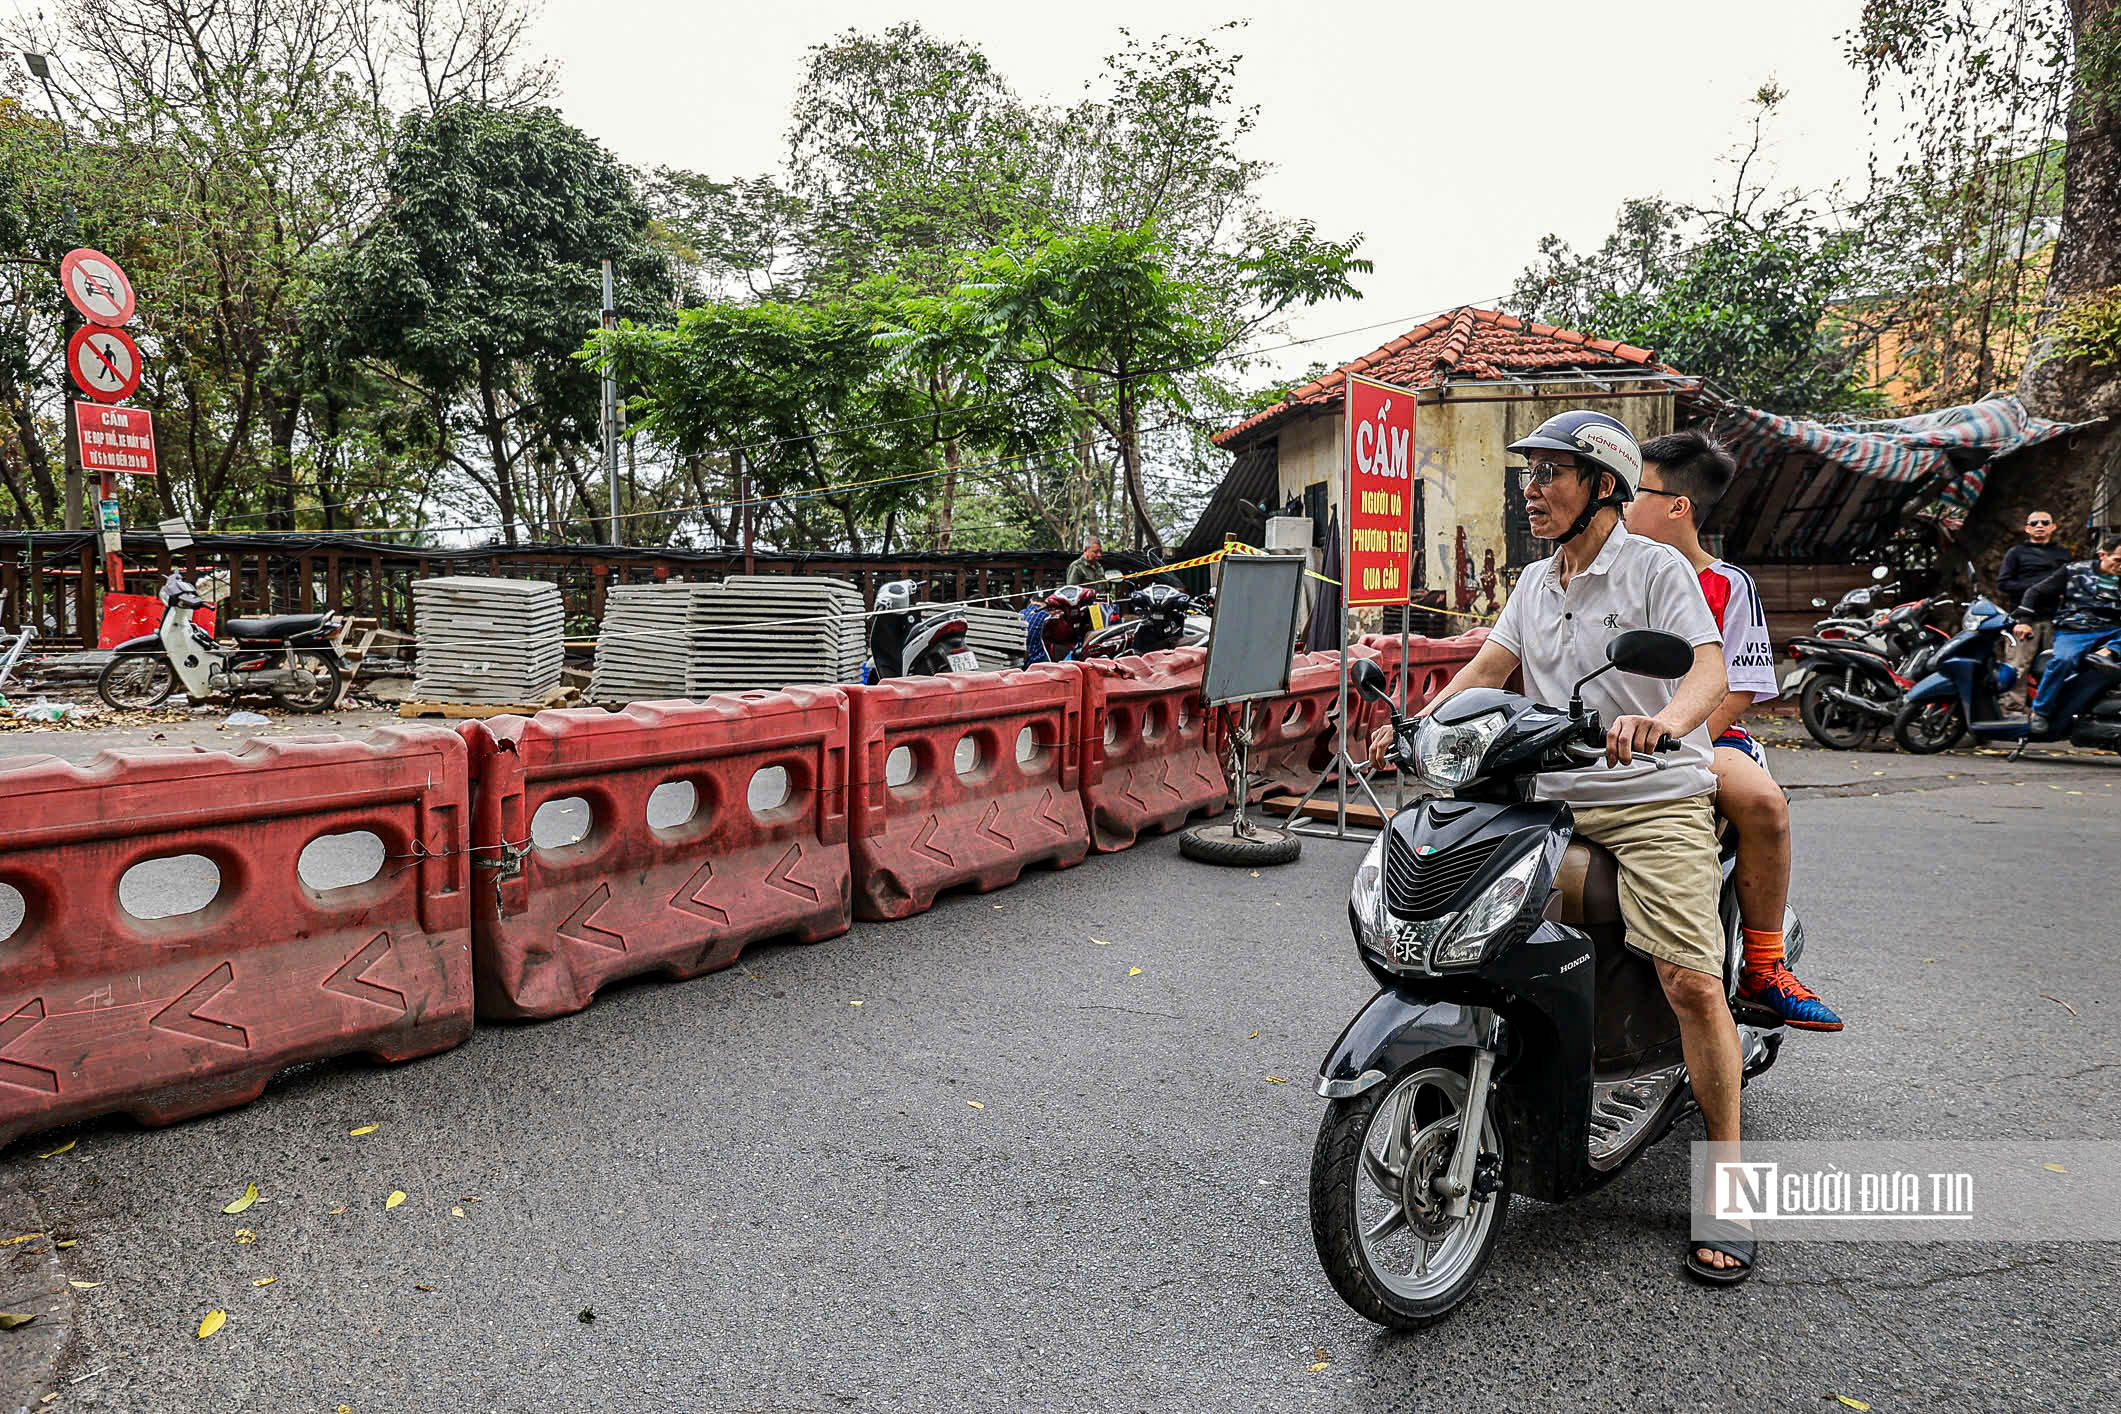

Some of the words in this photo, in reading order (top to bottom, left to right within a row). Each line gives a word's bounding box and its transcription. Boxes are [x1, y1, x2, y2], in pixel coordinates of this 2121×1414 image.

[101, 409, 129, 427] CẤM
[1355, 398, 1410, 480] CẤM
[1361, 488, 1389, 516] NGƯỜI
[1390, 489, 1402, 517] VÀ
[1352, 528, 1388, 553] PHƯƠNG
[1389, 527, 1408, 558] TIỆN
[1362, 566, 1381, 591] QUA
[1382, 559, 1400, 590] CẦU
[1560, 953, 1591, 974] HONDA
